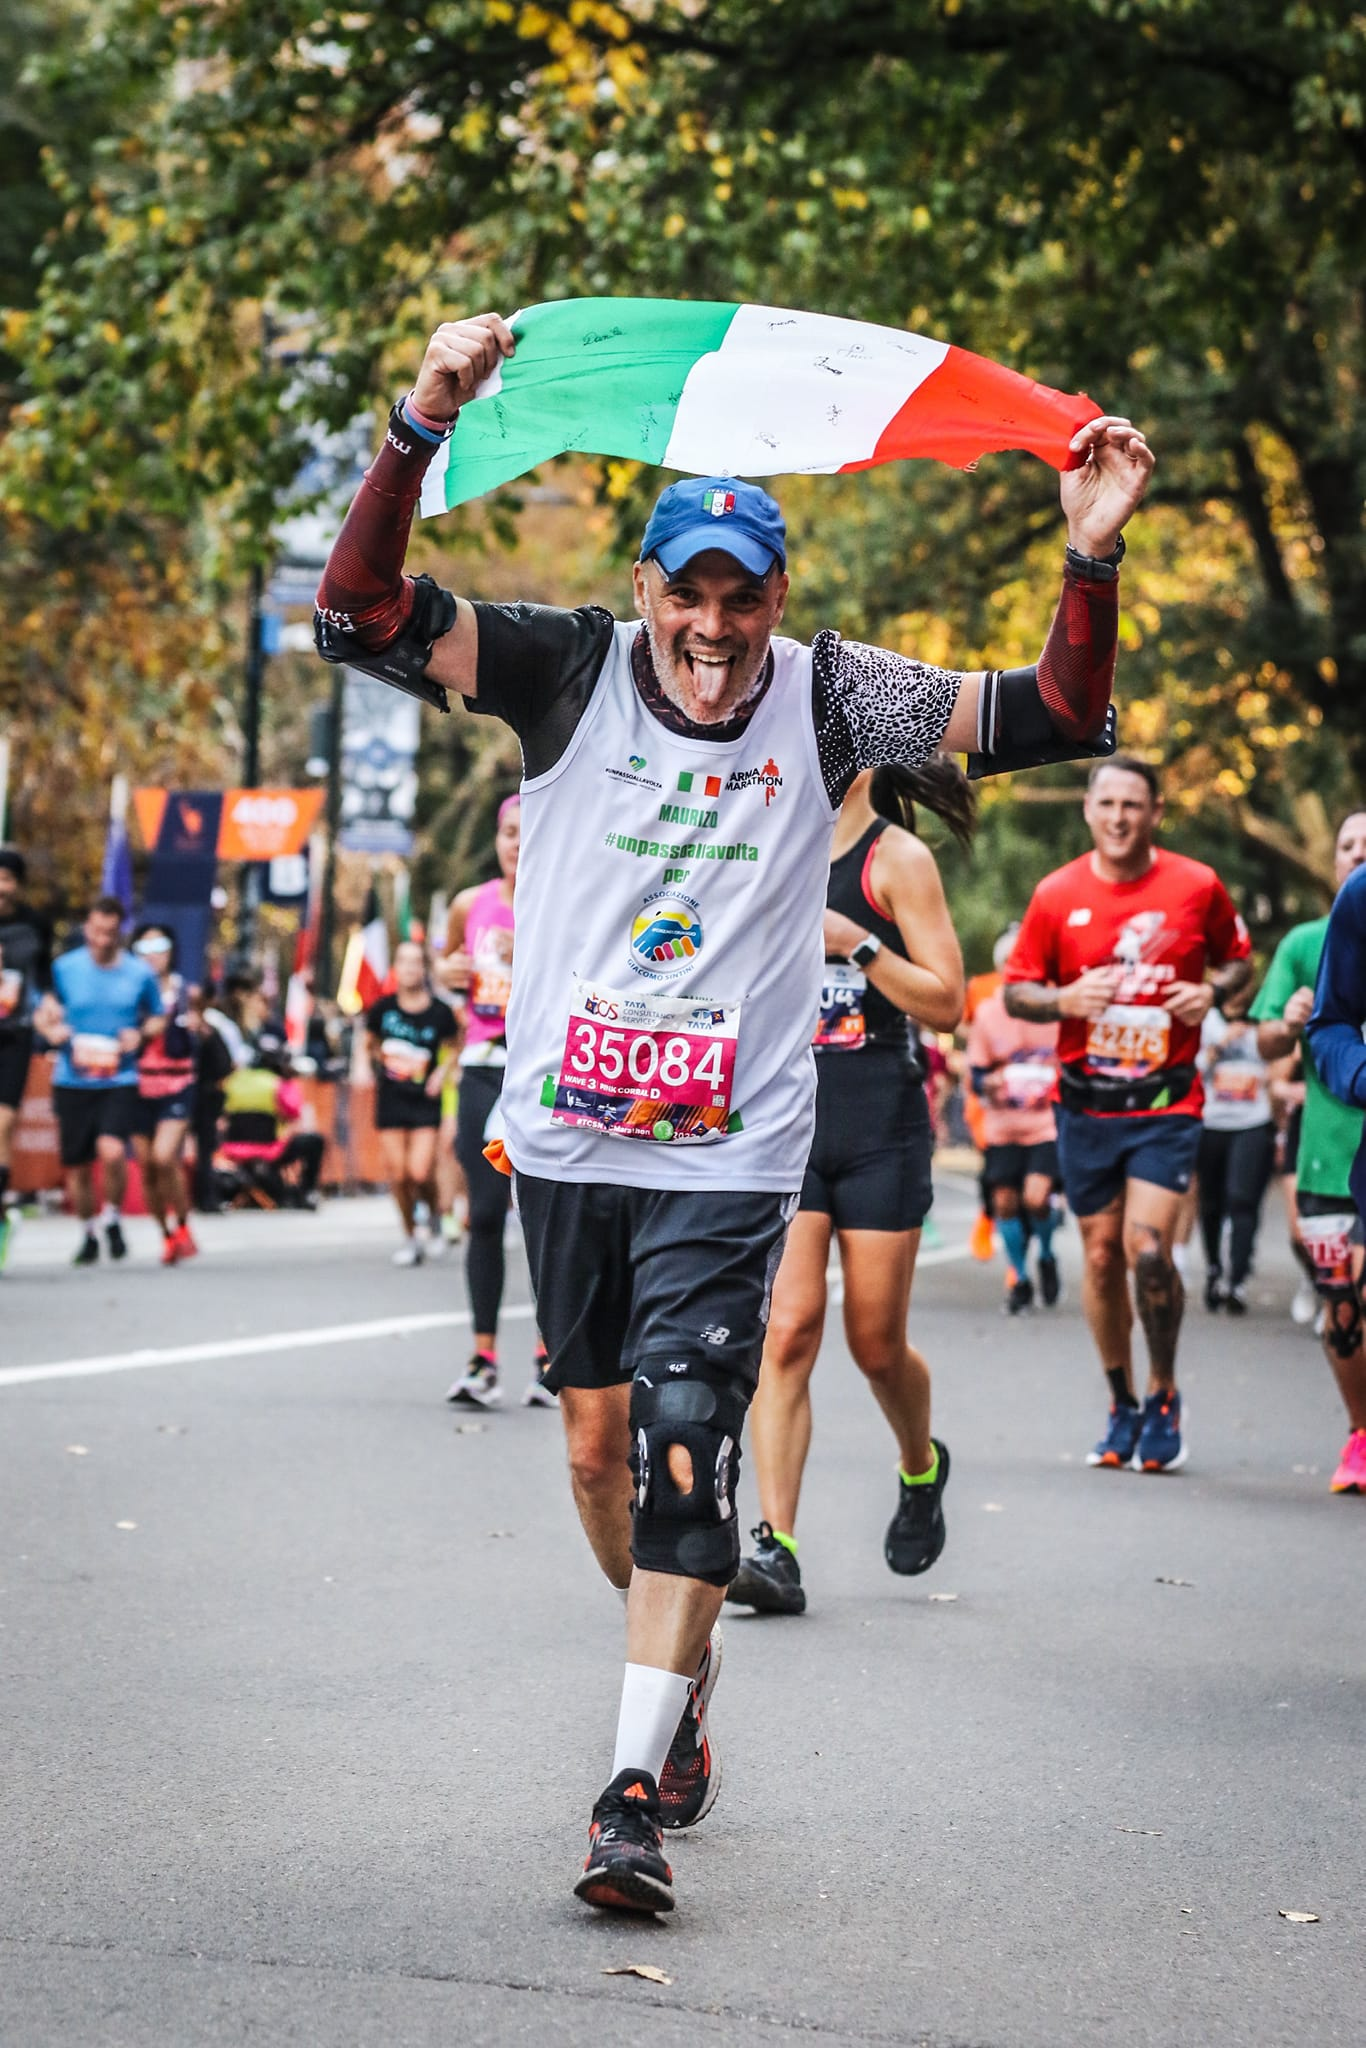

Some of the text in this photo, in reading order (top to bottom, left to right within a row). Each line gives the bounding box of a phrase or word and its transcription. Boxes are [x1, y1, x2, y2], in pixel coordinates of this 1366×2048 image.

[730, 768, 760, 781] ARMA
[725, 776, 783, 791] MARATHON
[604, 832, 758, 861] #unpassoallavolta
[662, 868, 690, 885] per
[643, 891, 700, 909] ASSOCIAZIONE
[627, 958, 695, 981] GIACOMO SINTINI
[624, 1000, 646, 1009] TATA
[623, 1008, 675, 1020] CONSULTANCY
[687, 1020, 712, 1030] TATA
[571, 1024, 724, 1090] 35084
[564, 1074, 586, 1087] WAVE
[587, 1078, 597, 1090] 3
[618, 1087, 649, 1097] CORRAL
[650, 1087, 661, 1099] D
